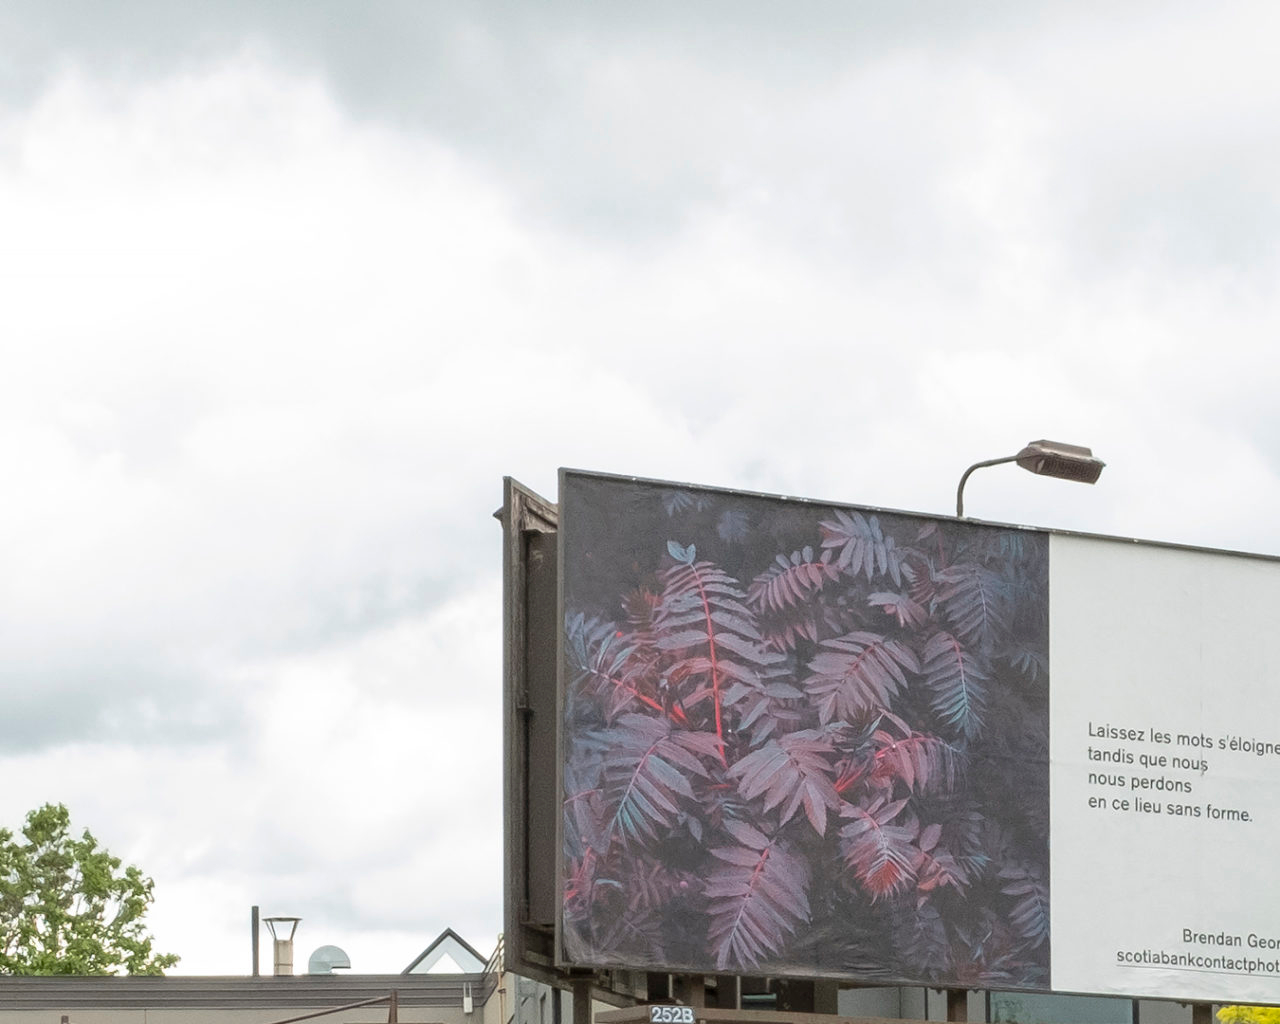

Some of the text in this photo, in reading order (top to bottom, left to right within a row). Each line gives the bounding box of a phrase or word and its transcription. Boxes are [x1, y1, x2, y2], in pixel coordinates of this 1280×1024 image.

[1088, 721, 1145, 742] Laissez
[1150, 727, 1172, 745] les
[1177, 732, 1213, 749] mots
[1088, 746, 1209, 773] tandis que nous
[1088, 772, 1193, 794] nous perdons
[1088, 796, 1254, 823] en ce lieu sans forme.
[1182, 928, 1242, 947] Brendan
[651, 1005, 694, 1024] 252B
